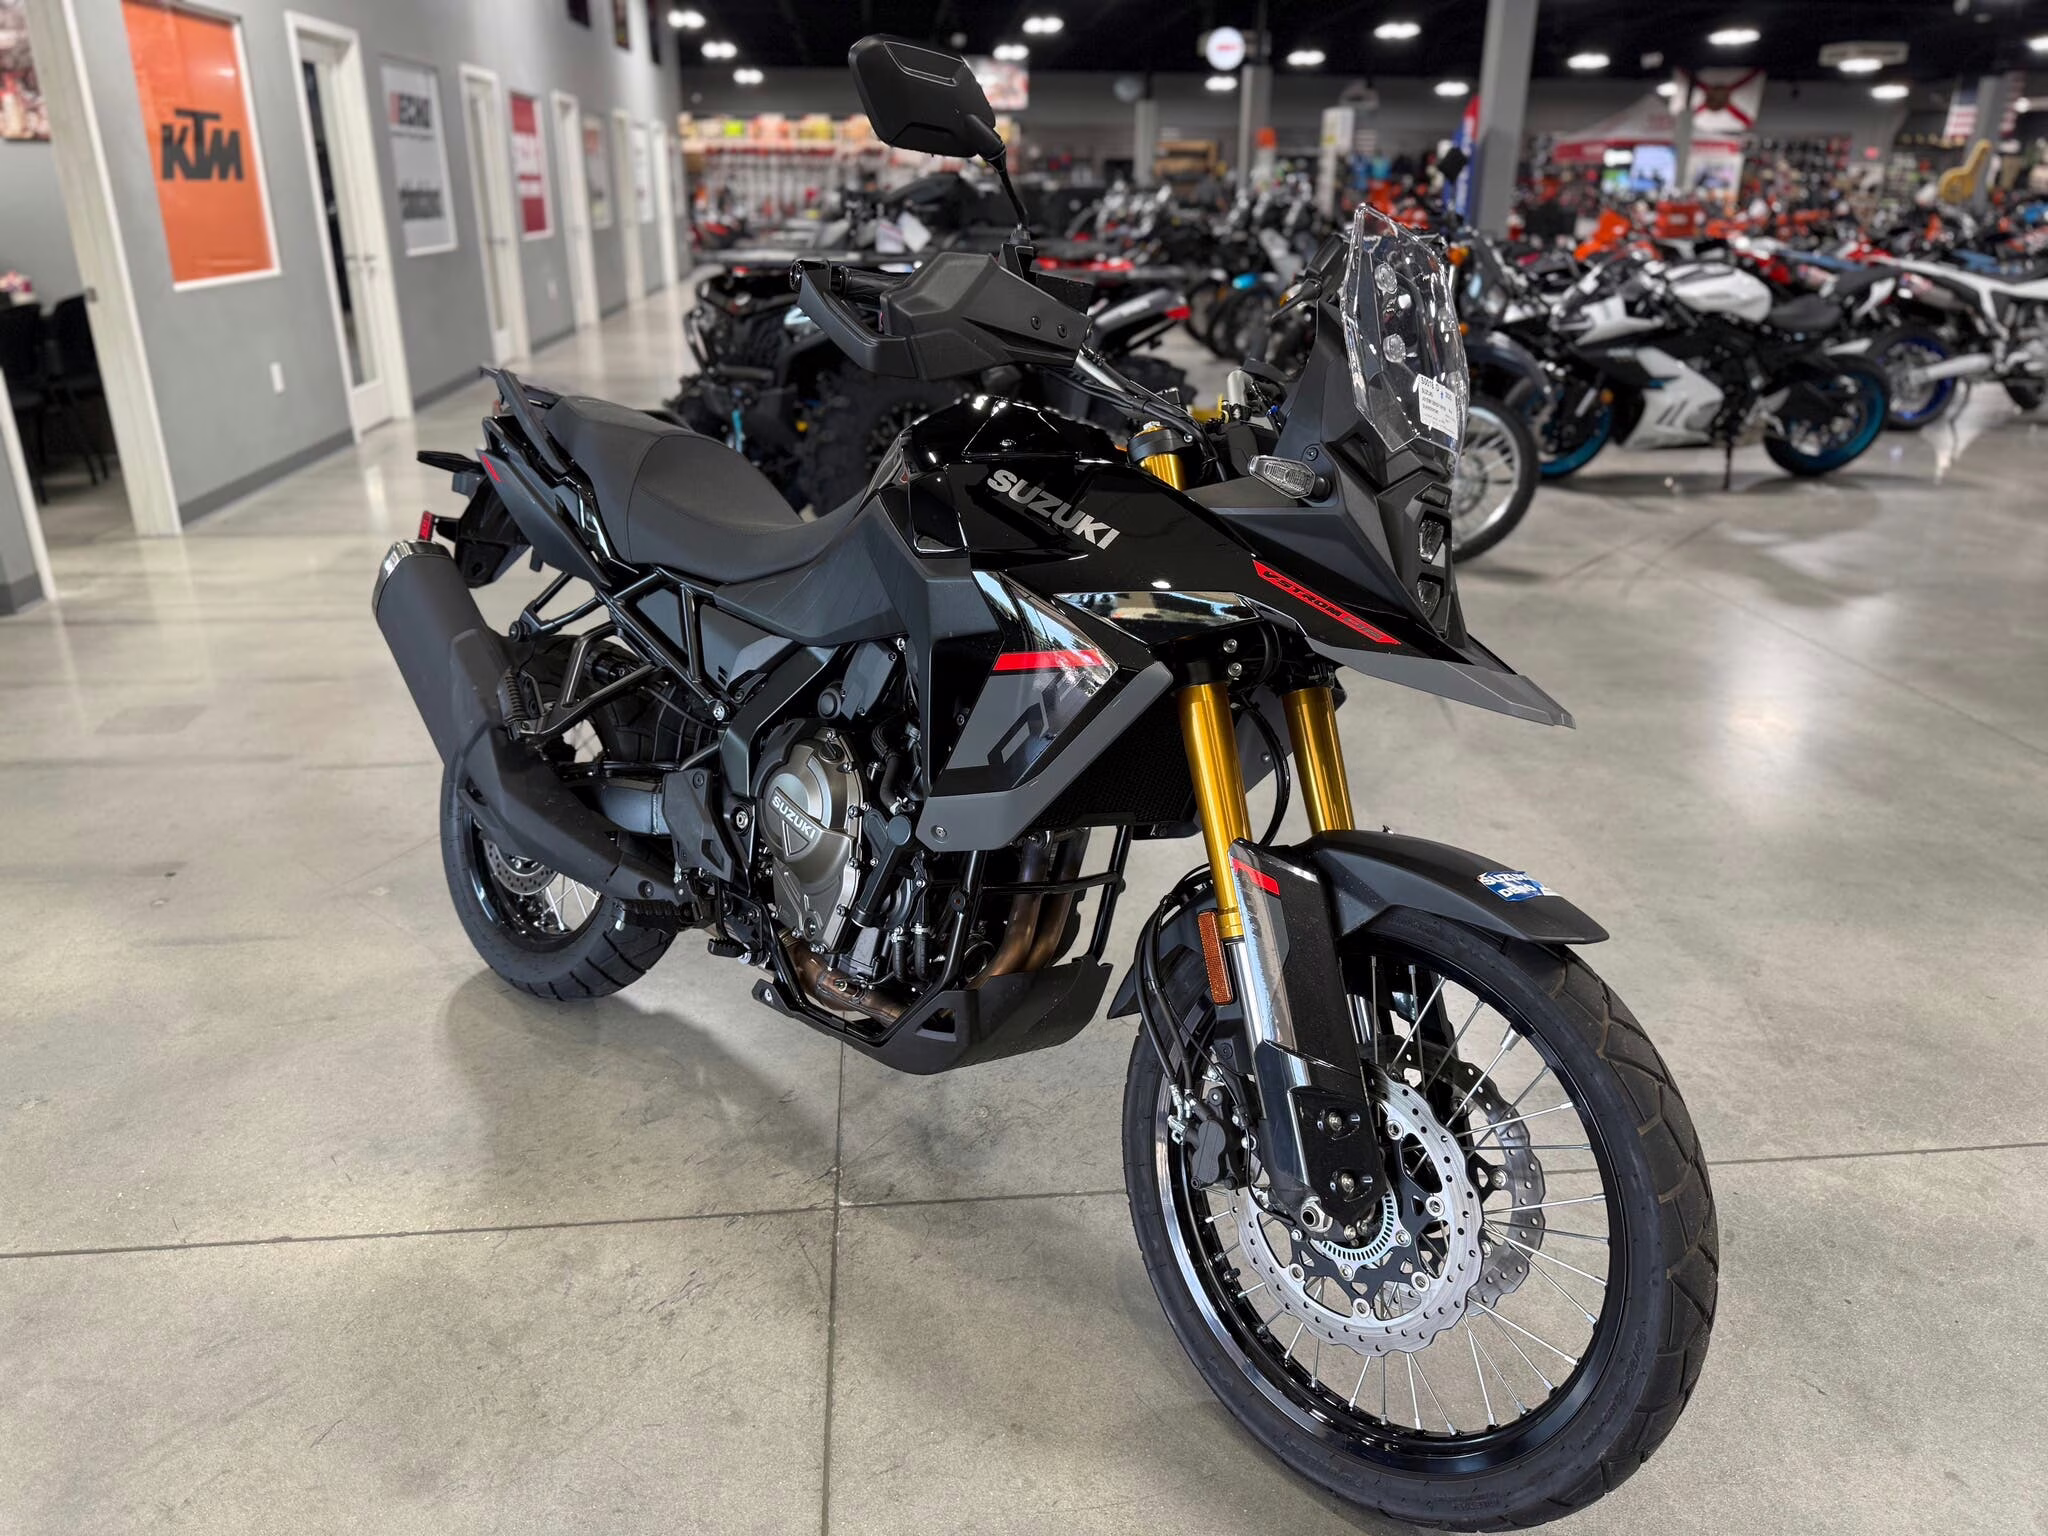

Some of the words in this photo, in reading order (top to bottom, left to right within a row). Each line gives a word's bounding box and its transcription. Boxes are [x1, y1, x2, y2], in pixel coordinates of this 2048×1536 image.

[162, 108, 244, 181] KTM
[987, 469, 1121, 550] SUZUKI
[772, 796, 816, 839] SUZUKI
